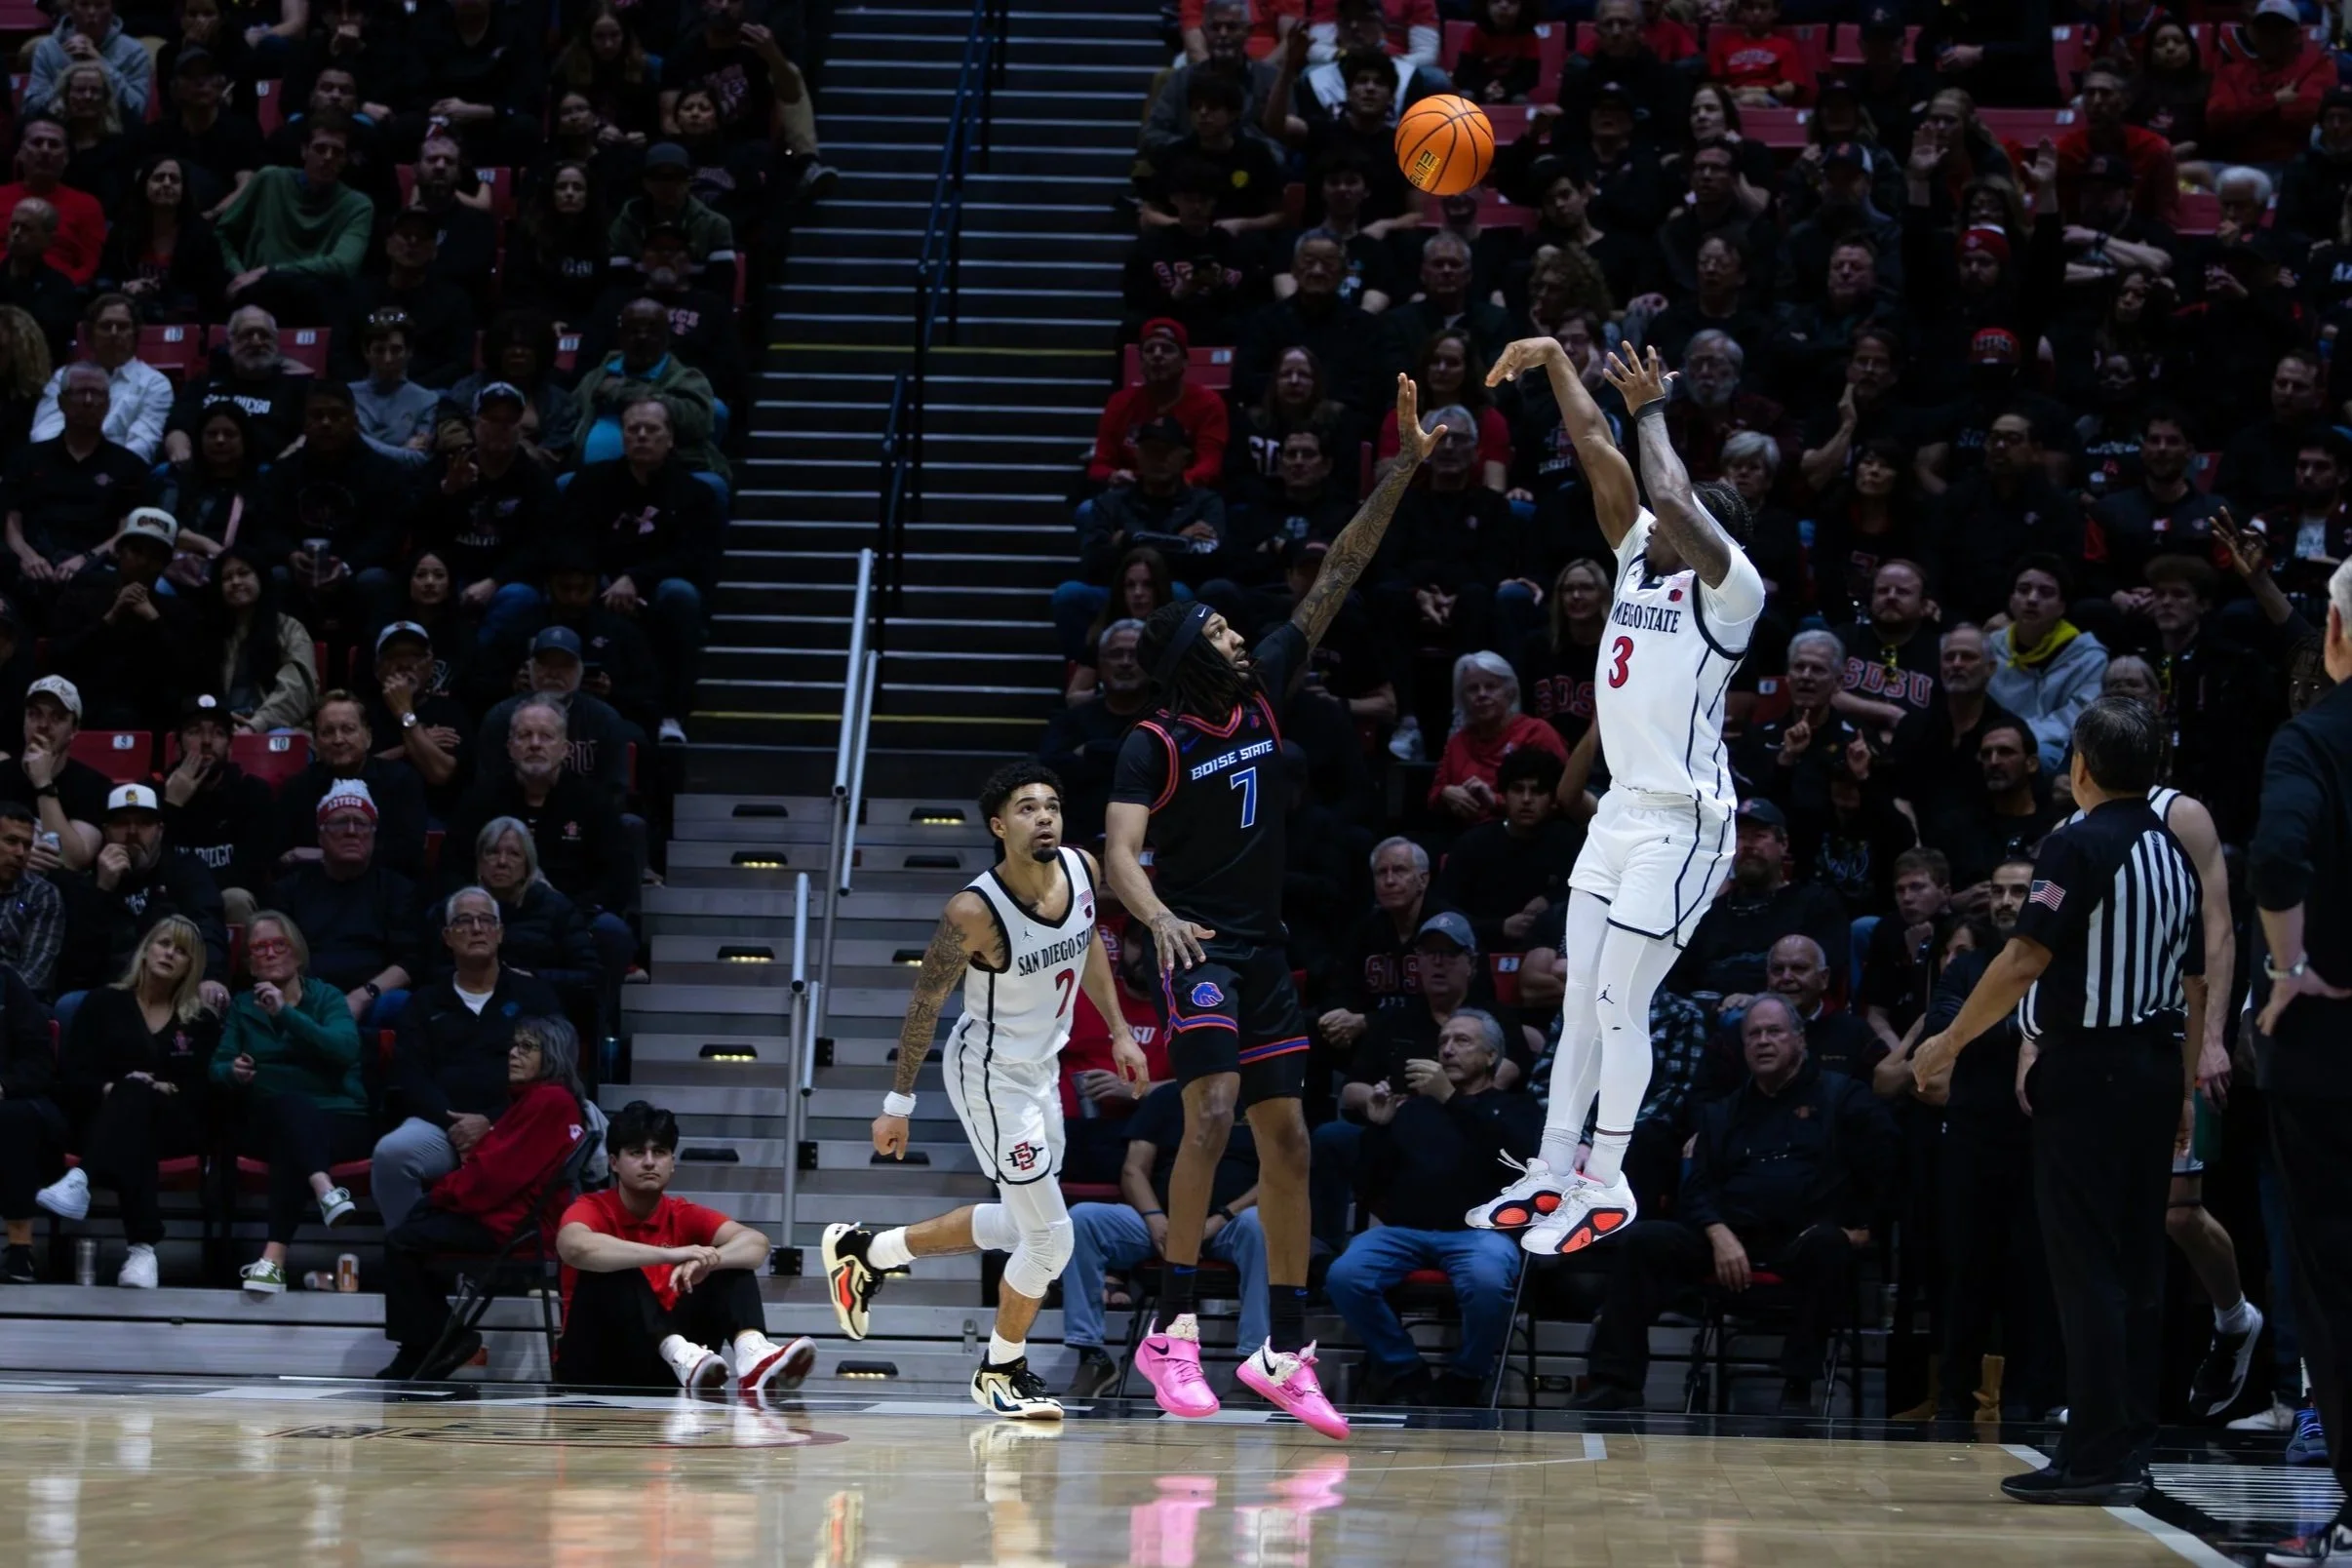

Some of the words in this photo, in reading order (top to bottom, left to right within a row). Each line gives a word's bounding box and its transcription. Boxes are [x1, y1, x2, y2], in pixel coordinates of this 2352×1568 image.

[1642, 606, 1681, 634] STATE
[1608, 636, 1634, 688] 3
[1842, 656, 1934, 710] SDSU
[1191, 751, 1237, 780] BOISE
[1239, 739, 1274, 761] STATE
[1230, 765, 1257, 829] 7
[1018, 949, 1041, 977] SAN
[1042, 938, 1076, 973] DIEGO
